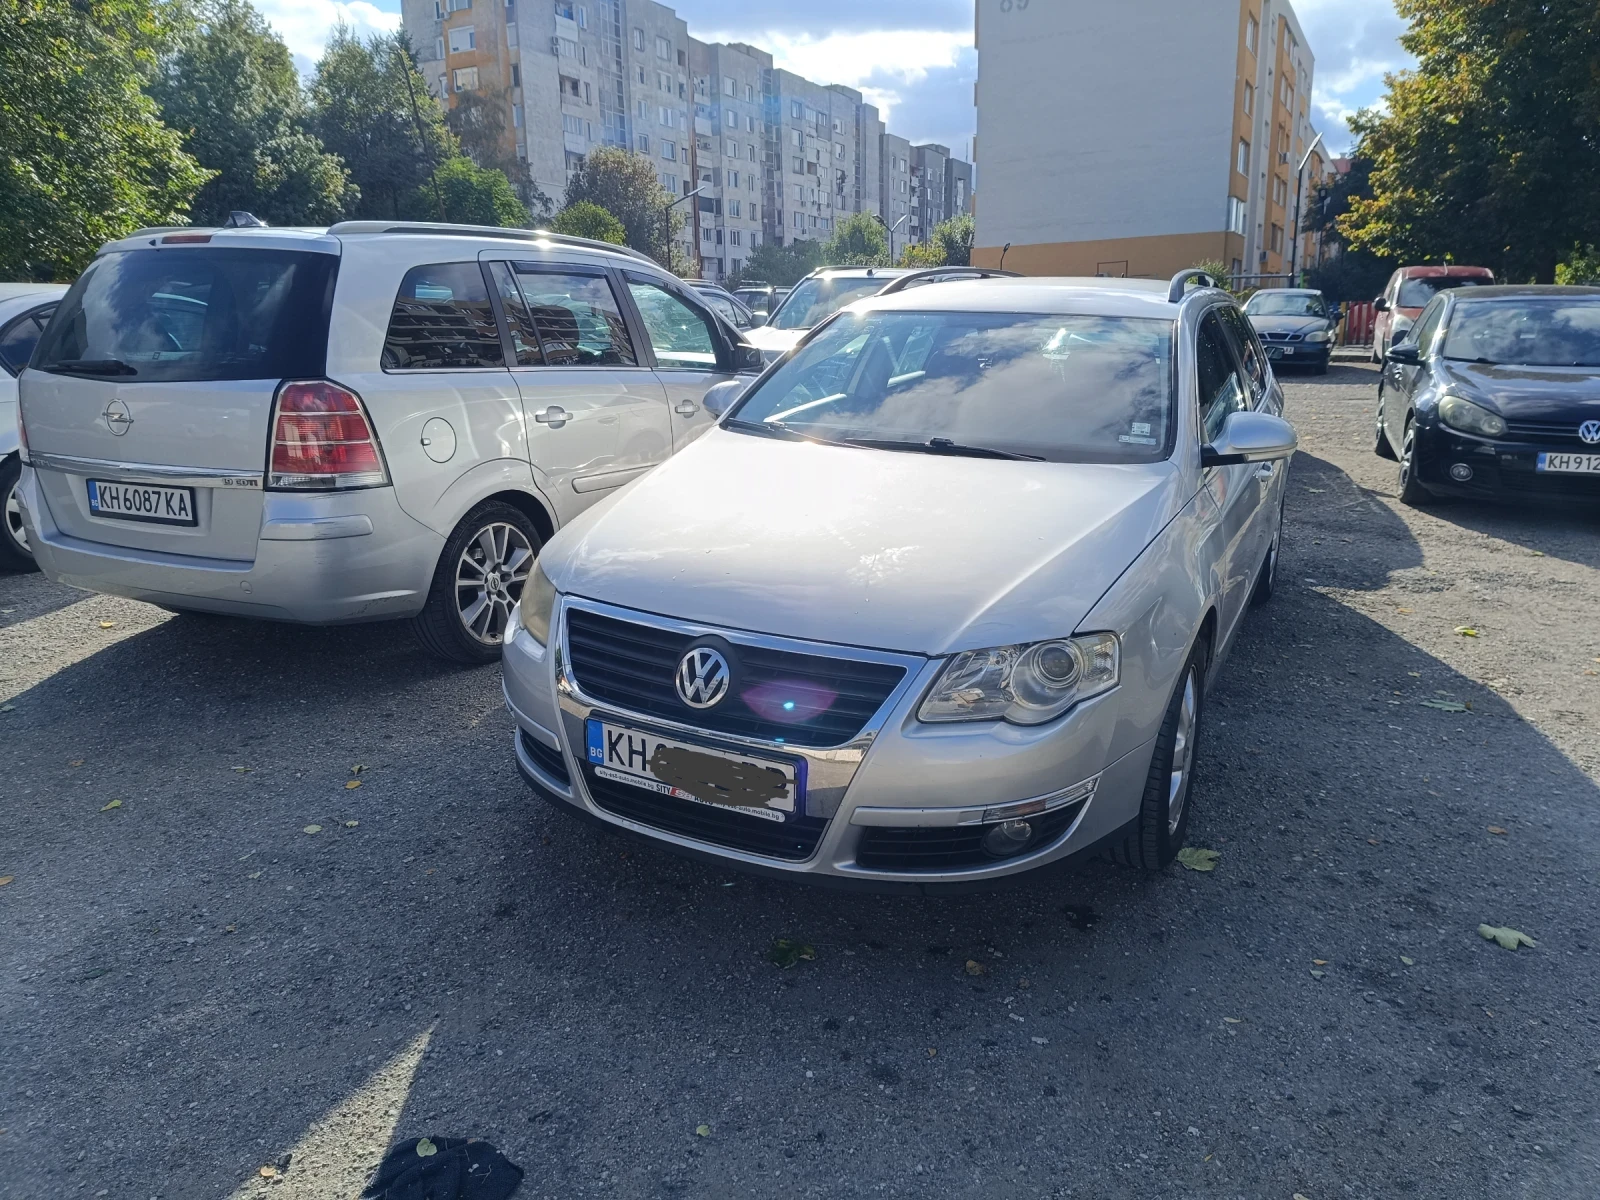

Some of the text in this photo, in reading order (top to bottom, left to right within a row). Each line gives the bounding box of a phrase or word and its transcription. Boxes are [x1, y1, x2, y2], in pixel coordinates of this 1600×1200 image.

[1548, 455, 1600, 470] KH912
[98, 485, 189, 517] KH6087KA
[675, 647, 730, 709] VW
[590, 746, 603, 758] BG
[656, 783, 671, 795] SITY
